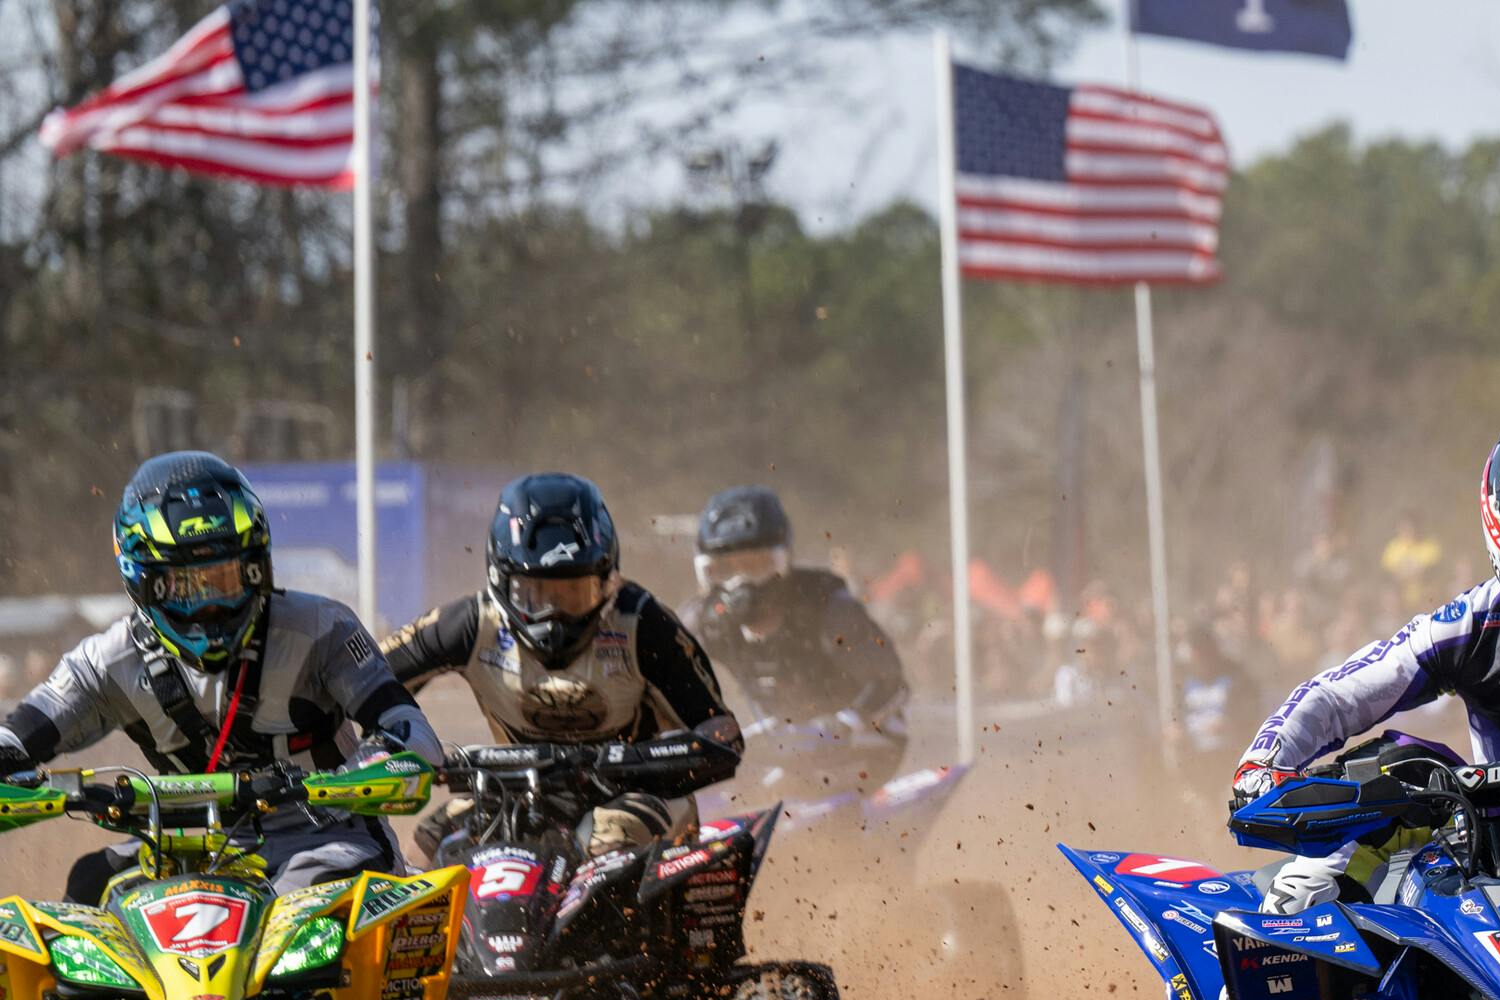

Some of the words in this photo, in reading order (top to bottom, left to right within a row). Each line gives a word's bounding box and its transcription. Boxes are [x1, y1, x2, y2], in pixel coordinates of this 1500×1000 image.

[608, 745, 624, 763] 5
[476, 861, 532, 898] 5
[171, 902, 230, 942] 7
[1262, 953, 1309, 967] KENDA
